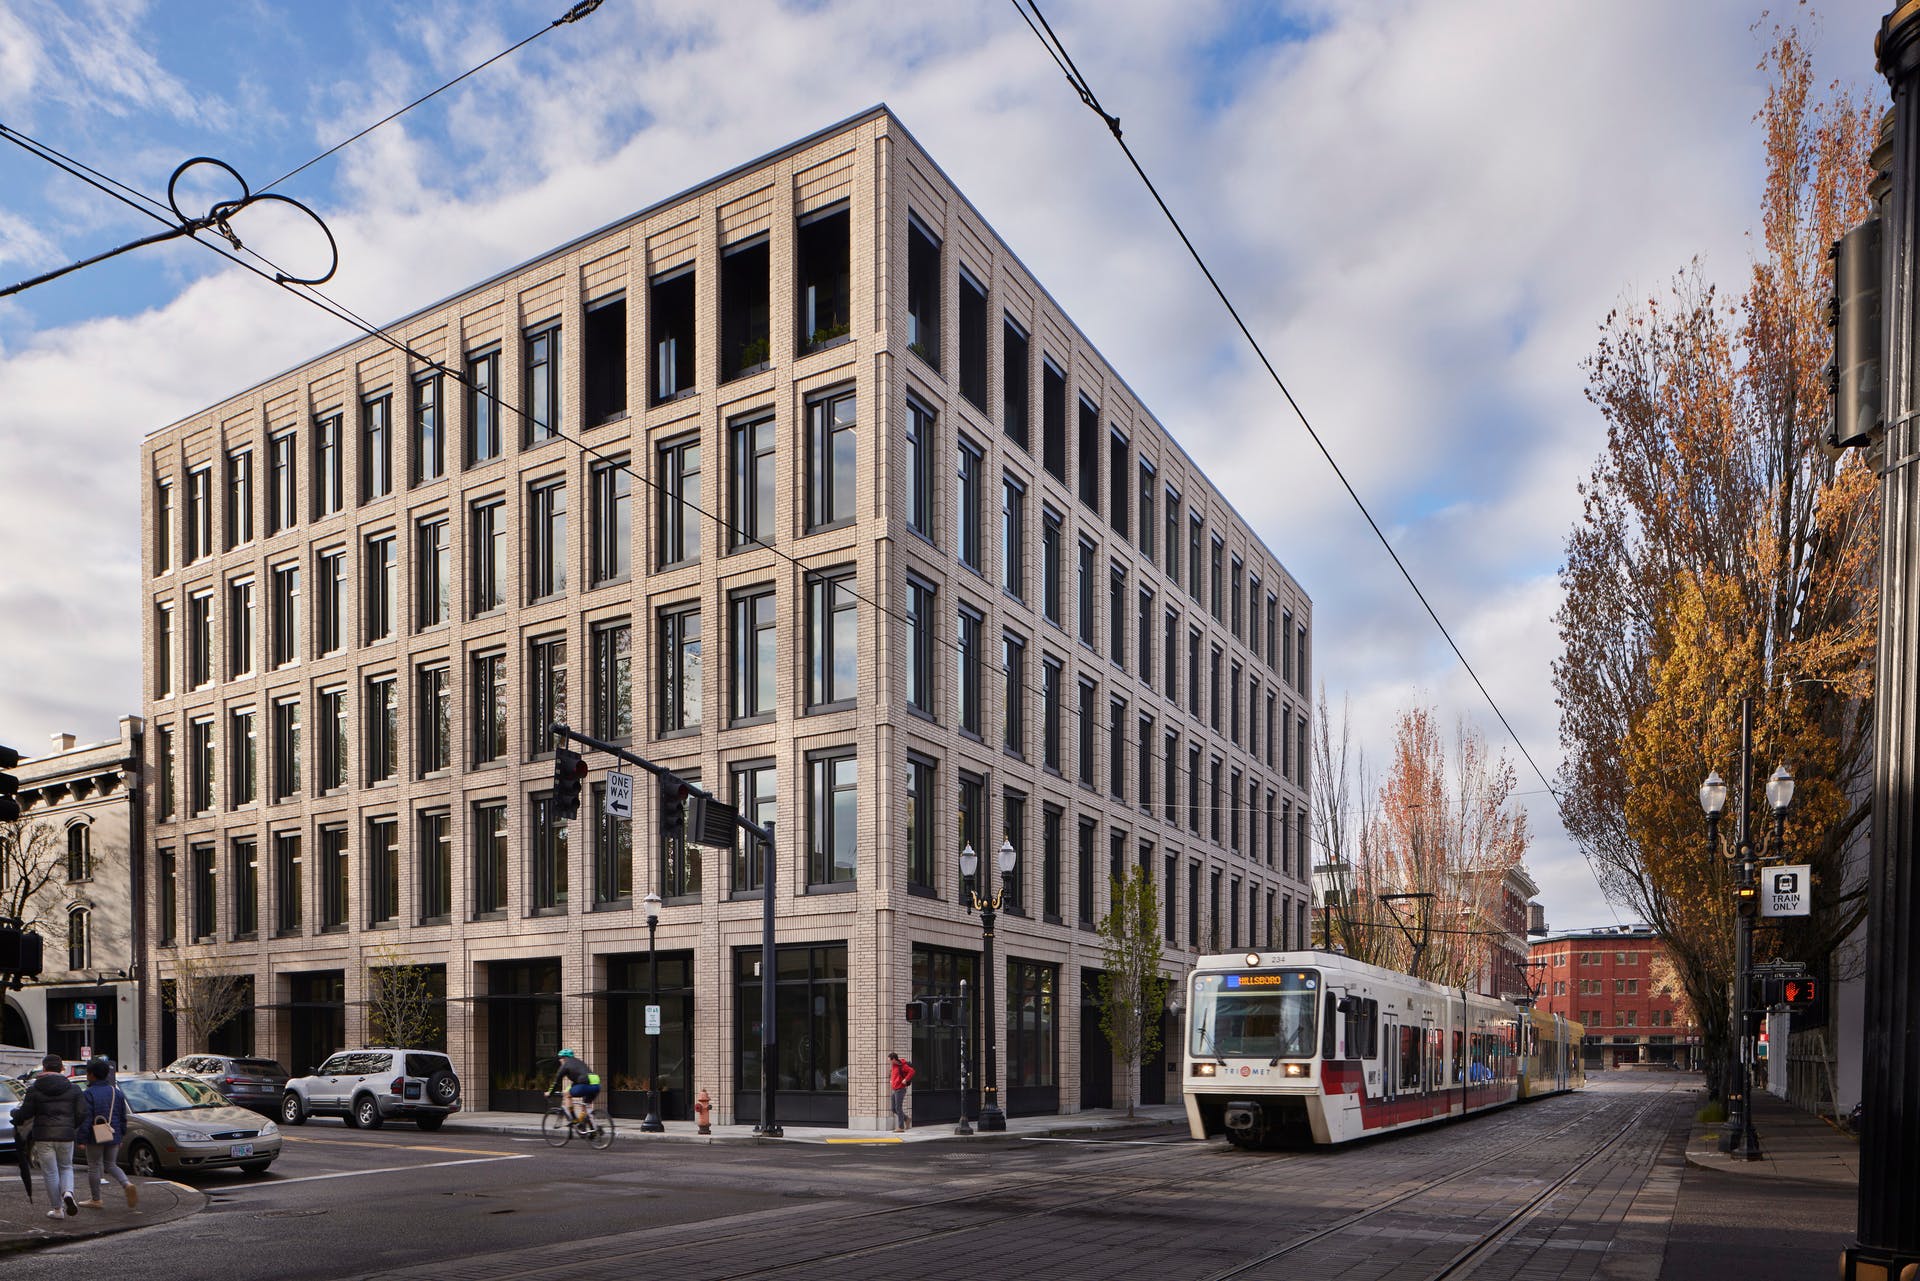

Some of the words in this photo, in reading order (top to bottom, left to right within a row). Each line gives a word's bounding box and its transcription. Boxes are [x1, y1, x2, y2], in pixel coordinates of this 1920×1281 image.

[611, 775, 629, 788] ONE
[611, 786, 629, 799] WAY
[1772, 894, 1800, 903] TRAIN
[1773, 902, 1798, 911] ONLY
[1271, 956, 1286, 964] 234
[1238, 975, 1281, 986] HILLSBORO
[1807, 982, 1815, 1000] 3
